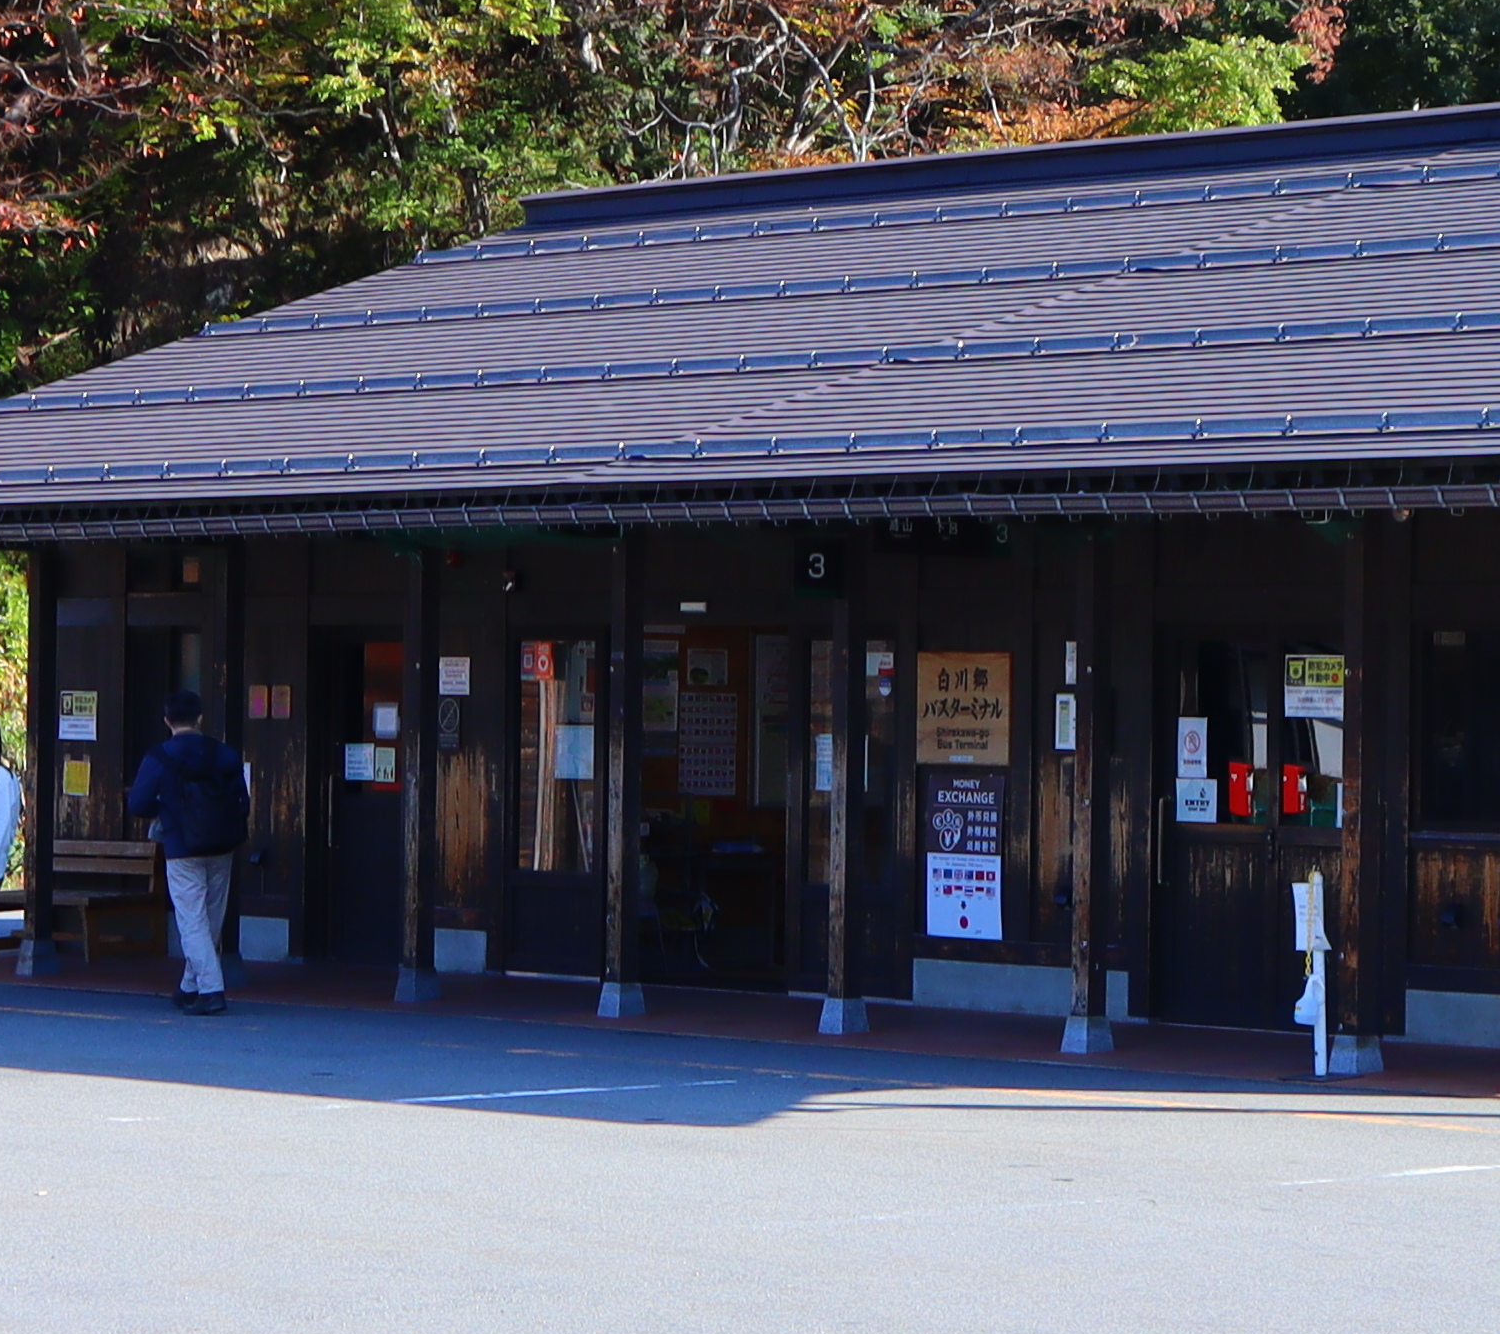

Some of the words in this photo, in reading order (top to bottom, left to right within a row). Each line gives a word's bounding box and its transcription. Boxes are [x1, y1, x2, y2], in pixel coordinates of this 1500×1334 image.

[996, 524, 1008, 544] 3
[808, 553, 825, 579] 3
[938, 667, 988, 692] 白川郷
[923, 697, 1002, 720] バスターミナル
[937, 727, 989, 740] Shirakawa-go
[938, 739, 952, 750] Bus
[955, 739, 988, 750] Terminal
[953, 779, 980, 789] MONEY
[937, 790, 996, 805] EXCHANGE
